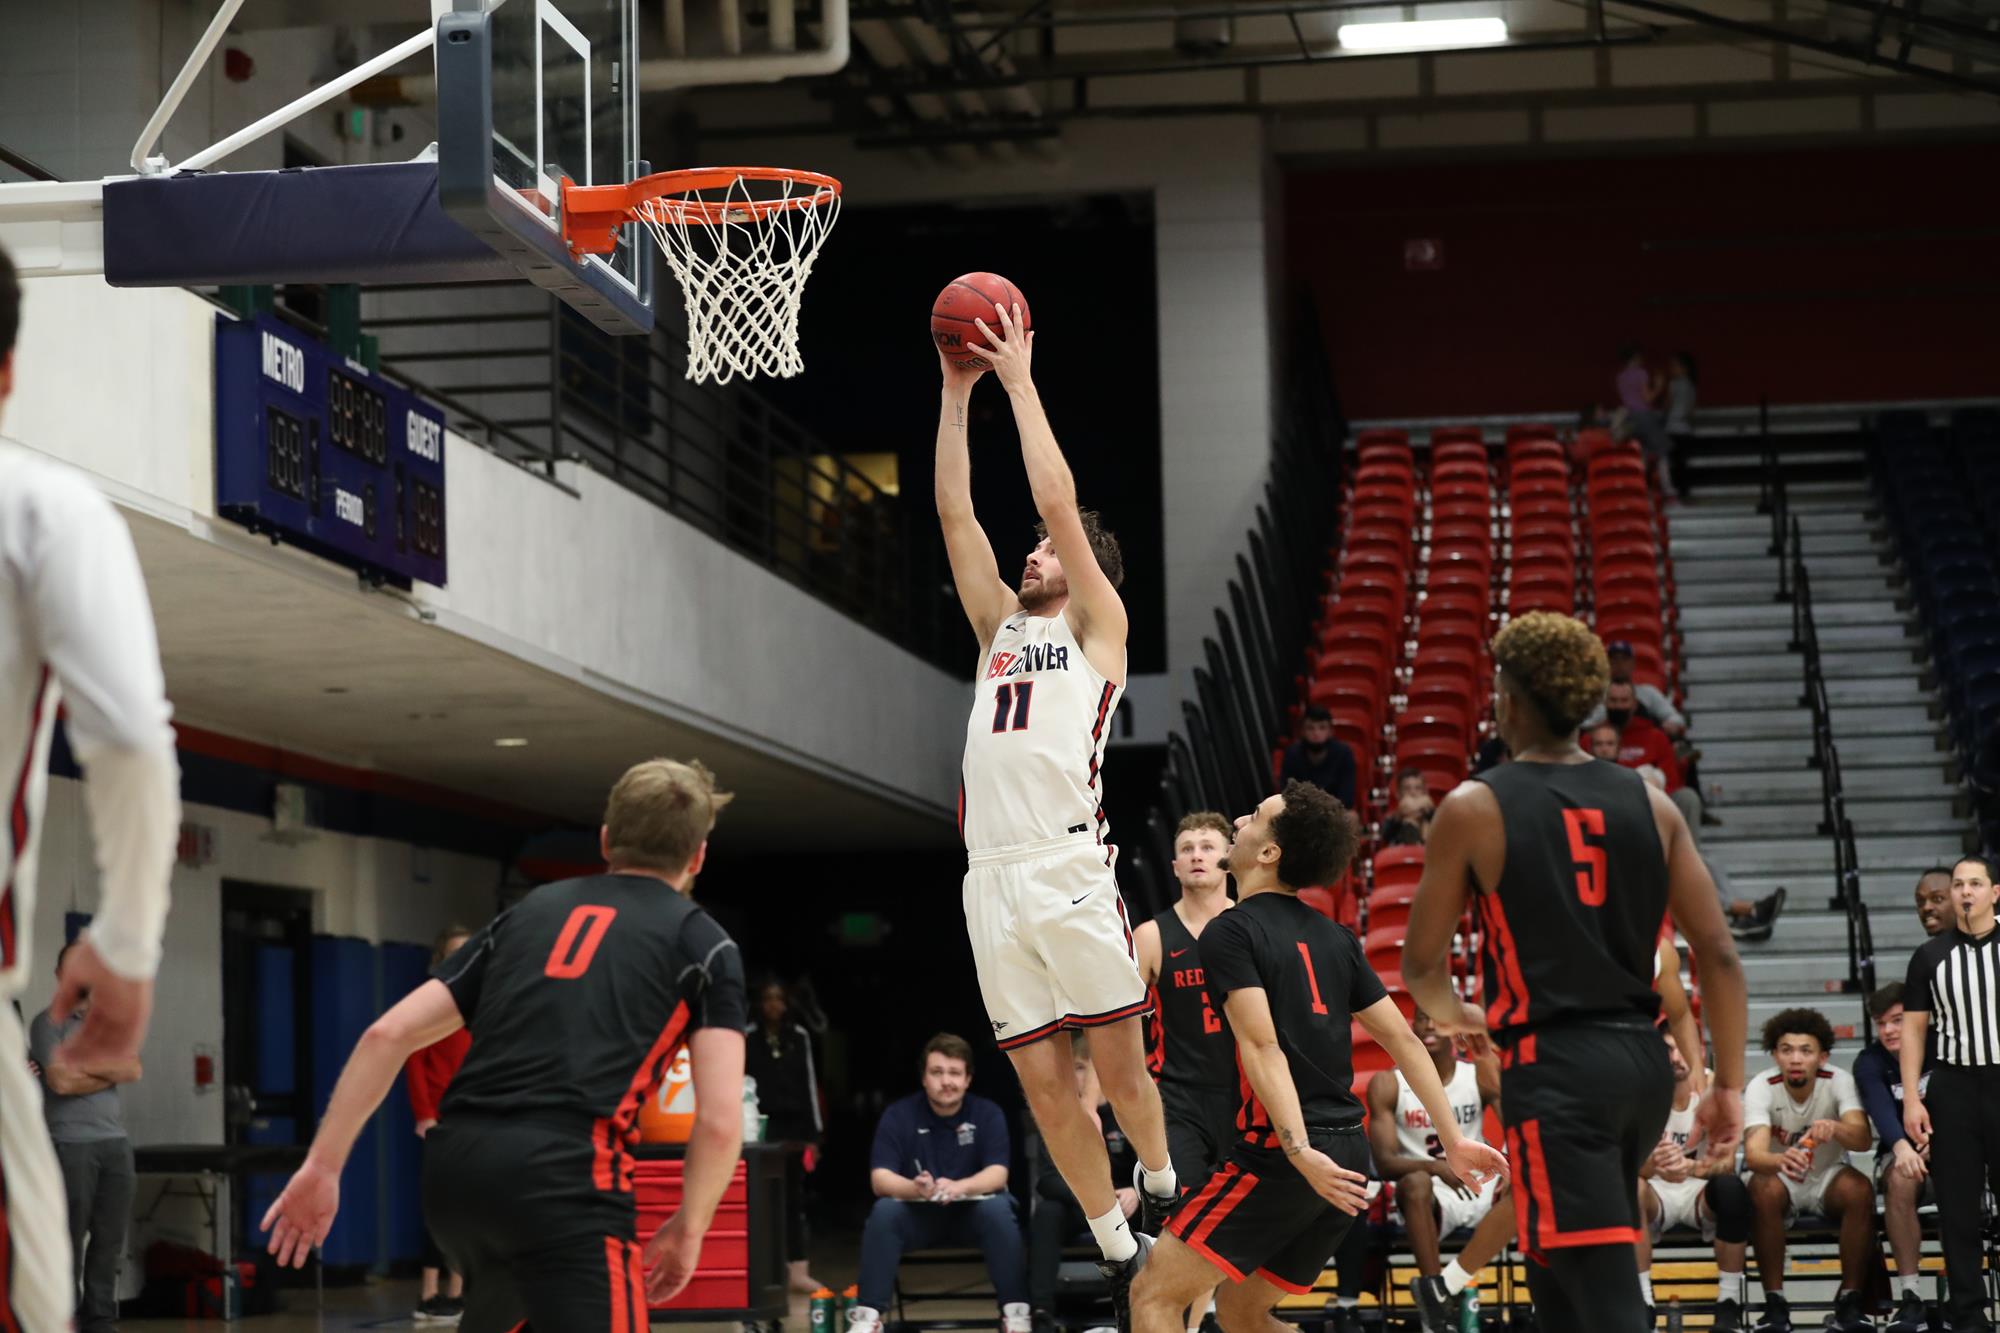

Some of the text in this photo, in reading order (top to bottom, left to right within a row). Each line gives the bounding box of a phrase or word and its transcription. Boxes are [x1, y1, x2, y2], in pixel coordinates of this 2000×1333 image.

[262, 329, 304, 394] METRO
[406, 408, 441, 463] GUEST
[336, 487, 364, 527] PERIOD
[991, 680, 1034, 734] 11
[1561, 807, 1608, 907] 5
[544, 904, 618, 979] 0
[1296, 941, 1328, 1015] 1
